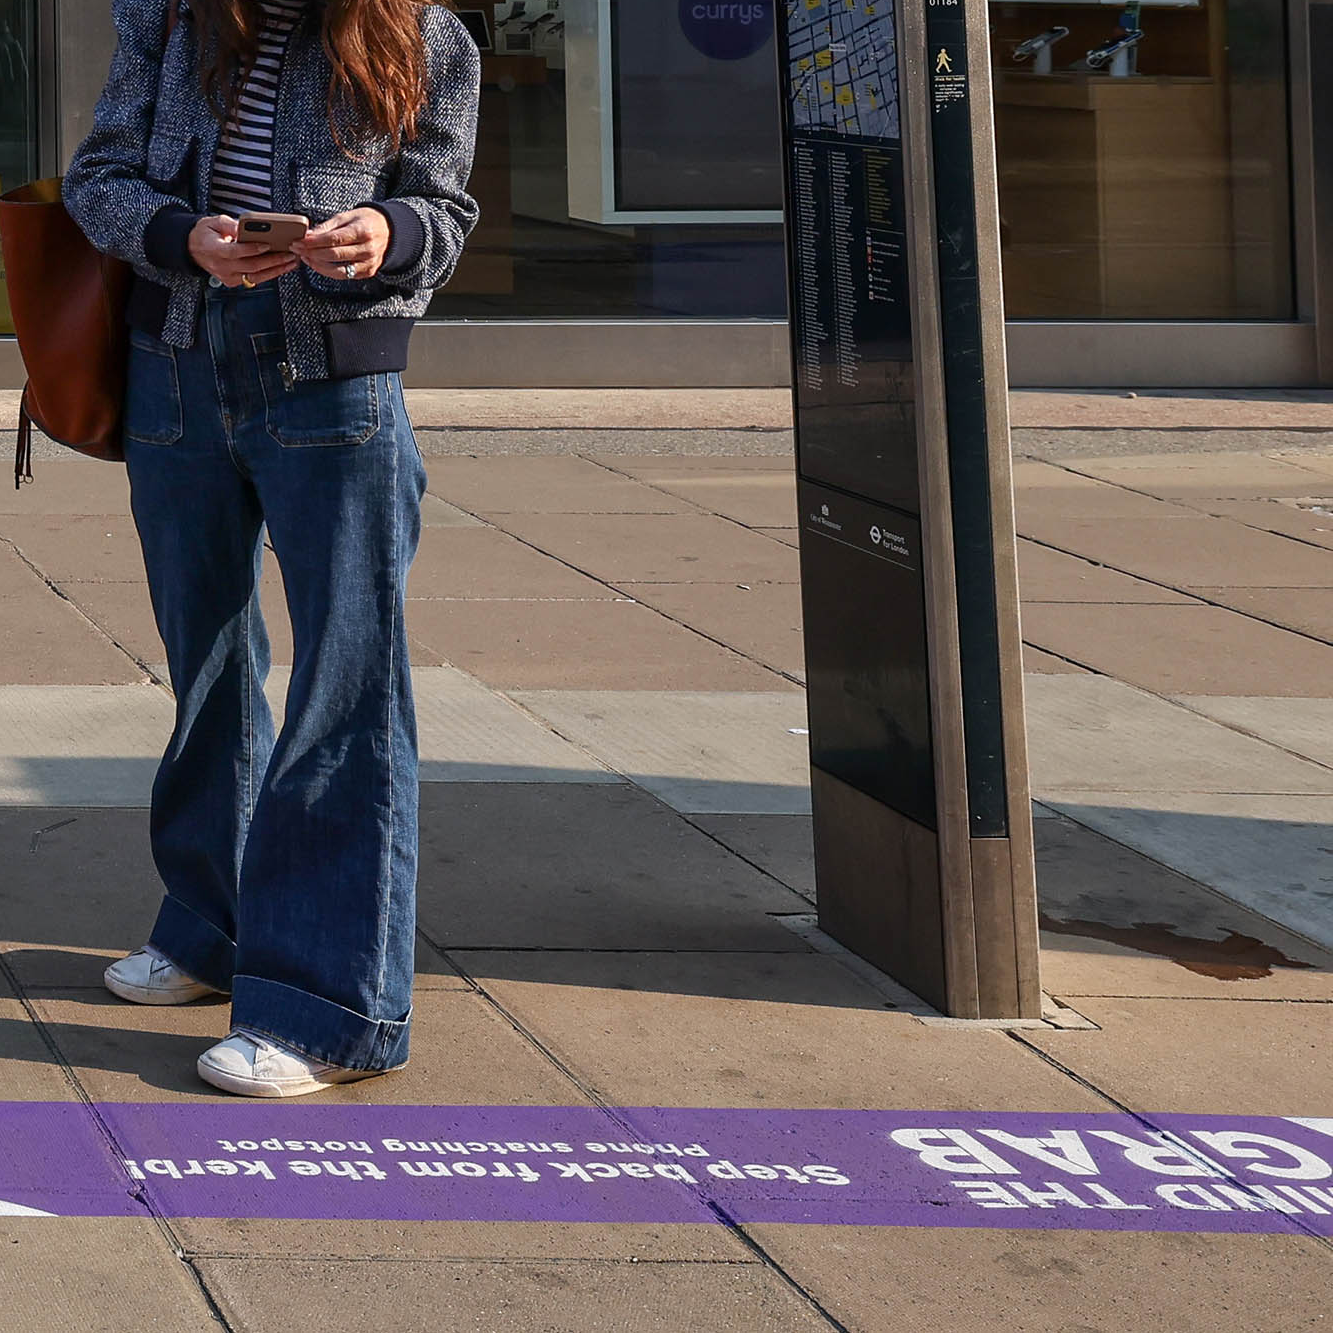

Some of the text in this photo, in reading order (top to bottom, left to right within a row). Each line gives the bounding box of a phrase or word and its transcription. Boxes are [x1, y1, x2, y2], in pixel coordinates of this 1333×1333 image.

[693, 4, 764, 25] currys
[217, 1137, 711, 1158] Phone snatching hotspot
[889, 1126, 1333, 1181] GRAB
[123, 1158, 851, 1187] Step back from the kerb!
[949, 1178, 1154, 1211] THE
